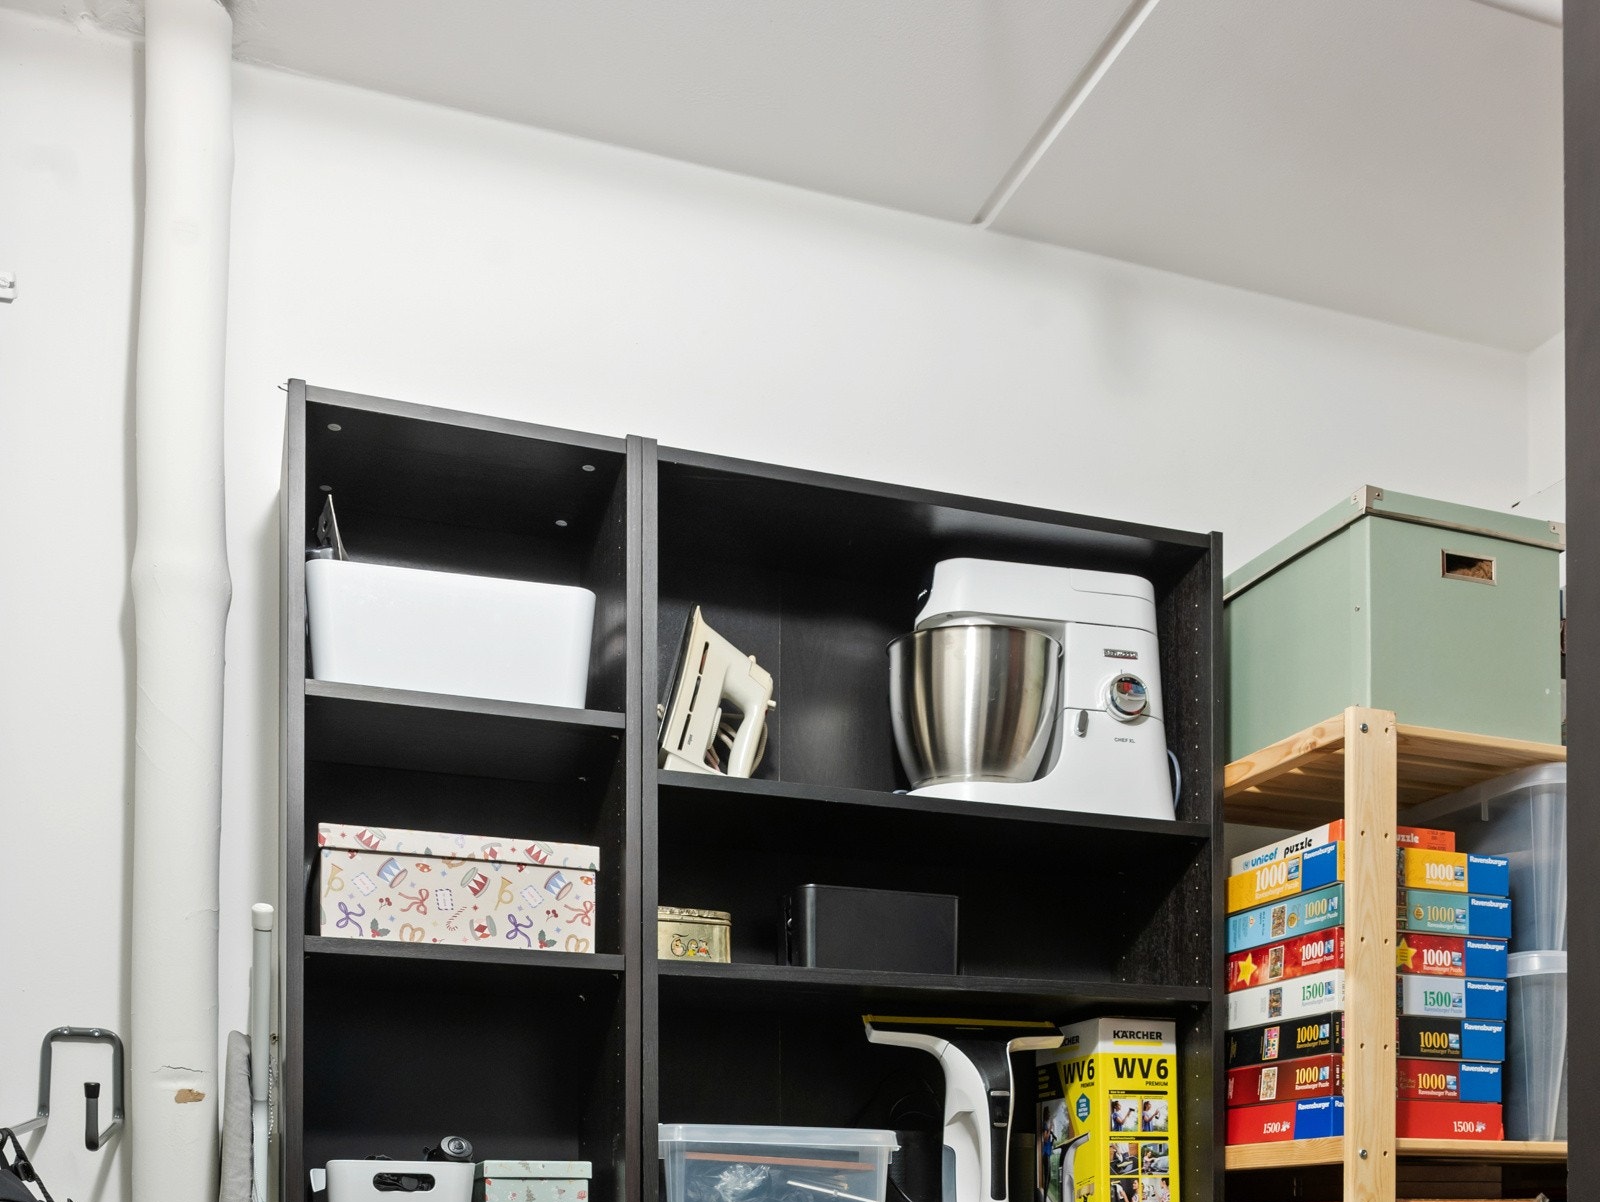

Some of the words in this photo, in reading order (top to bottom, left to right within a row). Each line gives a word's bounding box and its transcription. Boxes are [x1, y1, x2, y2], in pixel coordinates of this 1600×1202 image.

[1396, 833, 1419, 844] uzzle
[1250, 847, 1278, 867] unicef
[1284, 837, 1313, 858] puzzle
[1303, 845, 1336, 860] Ravensburger
[1469, 856, 1508, 867] Ravensburger
[1256, 862, 1287, 892] 1000
[1425, 863, 1453, 880] 1000
[1305, 898, 1327, 918] 1000
[1471, 899, 1509, 910] Ravensburger
[1427, 906, 1455, 922] 1000
[1301, 940, 1324, 961] 1000
[1467, 941, 1505, 952] Ravensburger
[1422, 949, 1451, 966] 1000
[1302, 982, 1324, 1001] 1500
[1467, 982, 1505, 992] Ravensburger
[1423, 991, 1451, 1007] 1500
[1113, 1030, 1163, 1040] KÄRCHER
[1296, 1024, 1319, 1043] 1000
[1464, 1023, 1502, 1033] Ravensburger
[1419, 1031, 1448, 1049] 1000
[1295, 1066, 1319, 1084] 1000
[1461, 1064, 1499, 1074] Ravensburger
[1295, 1083, 1318, 1091] Ravensburger
[1417, 1073, 1446, 1090] 1000
[1418, 1089, 1445, 1097] Ravensburger
[1297, 1101, 1330, 1111] Ravensburger
[1263, 1122, 1280, 1134] 1500
[1453, 1121, 1474, 1133] 1500
